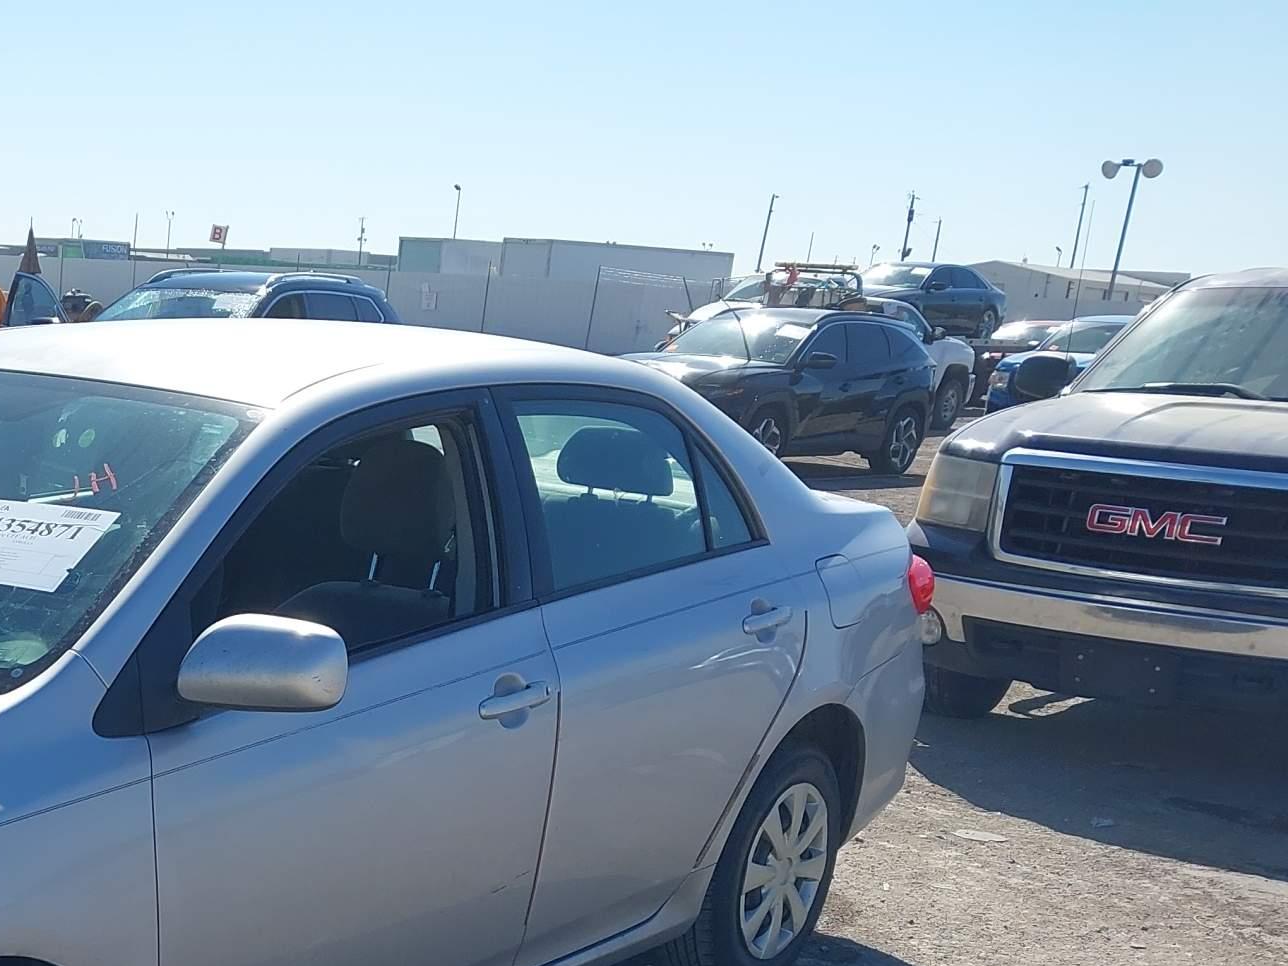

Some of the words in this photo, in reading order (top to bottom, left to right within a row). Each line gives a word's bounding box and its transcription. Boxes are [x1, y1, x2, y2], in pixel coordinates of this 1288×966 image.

[212, 226, 223, 241] B
[102, 244, 128, 254] FUSION
[1086, 503, 1228, 546] GMC
